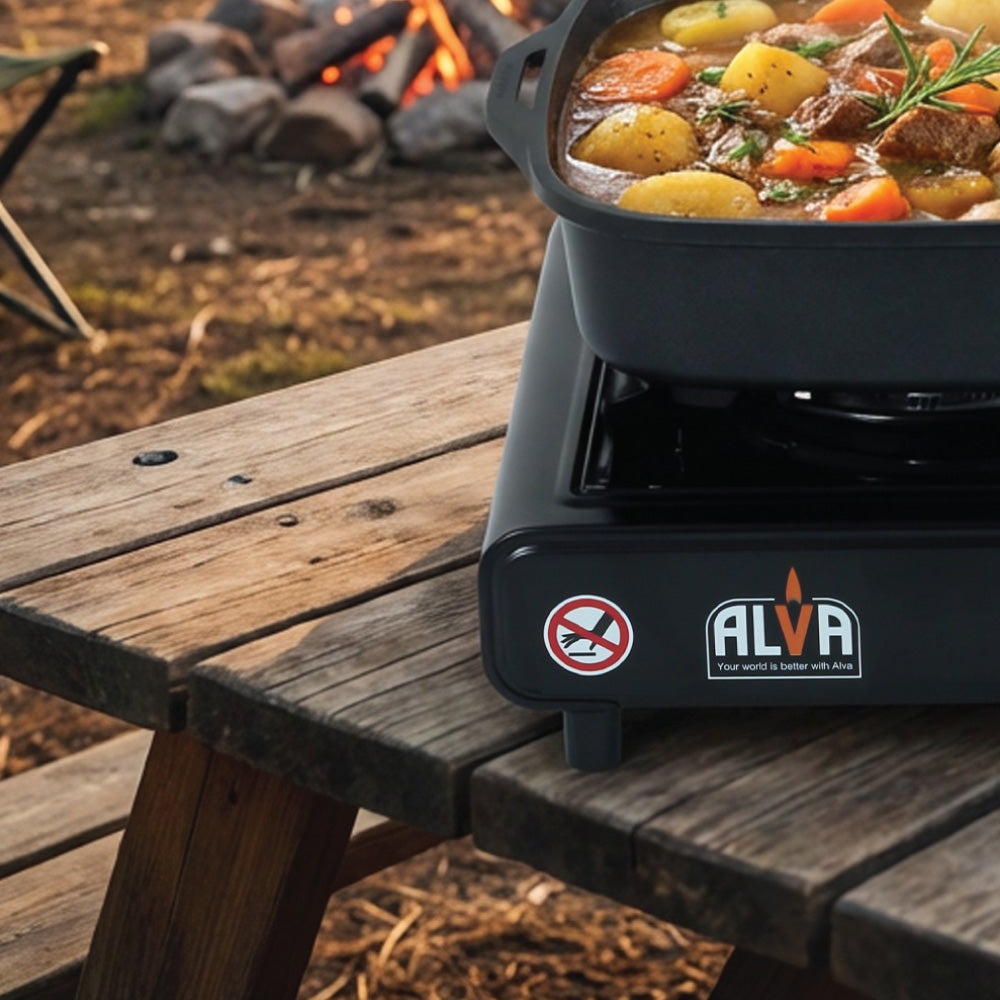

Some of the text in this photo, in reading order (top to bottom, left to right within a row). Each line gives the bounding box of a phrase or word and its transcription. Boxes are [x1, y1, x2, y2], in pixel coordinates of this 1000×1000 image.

[713, 604, 853, 656] ALVA
[717, 661, 854, 671] Your world is better with Alva
